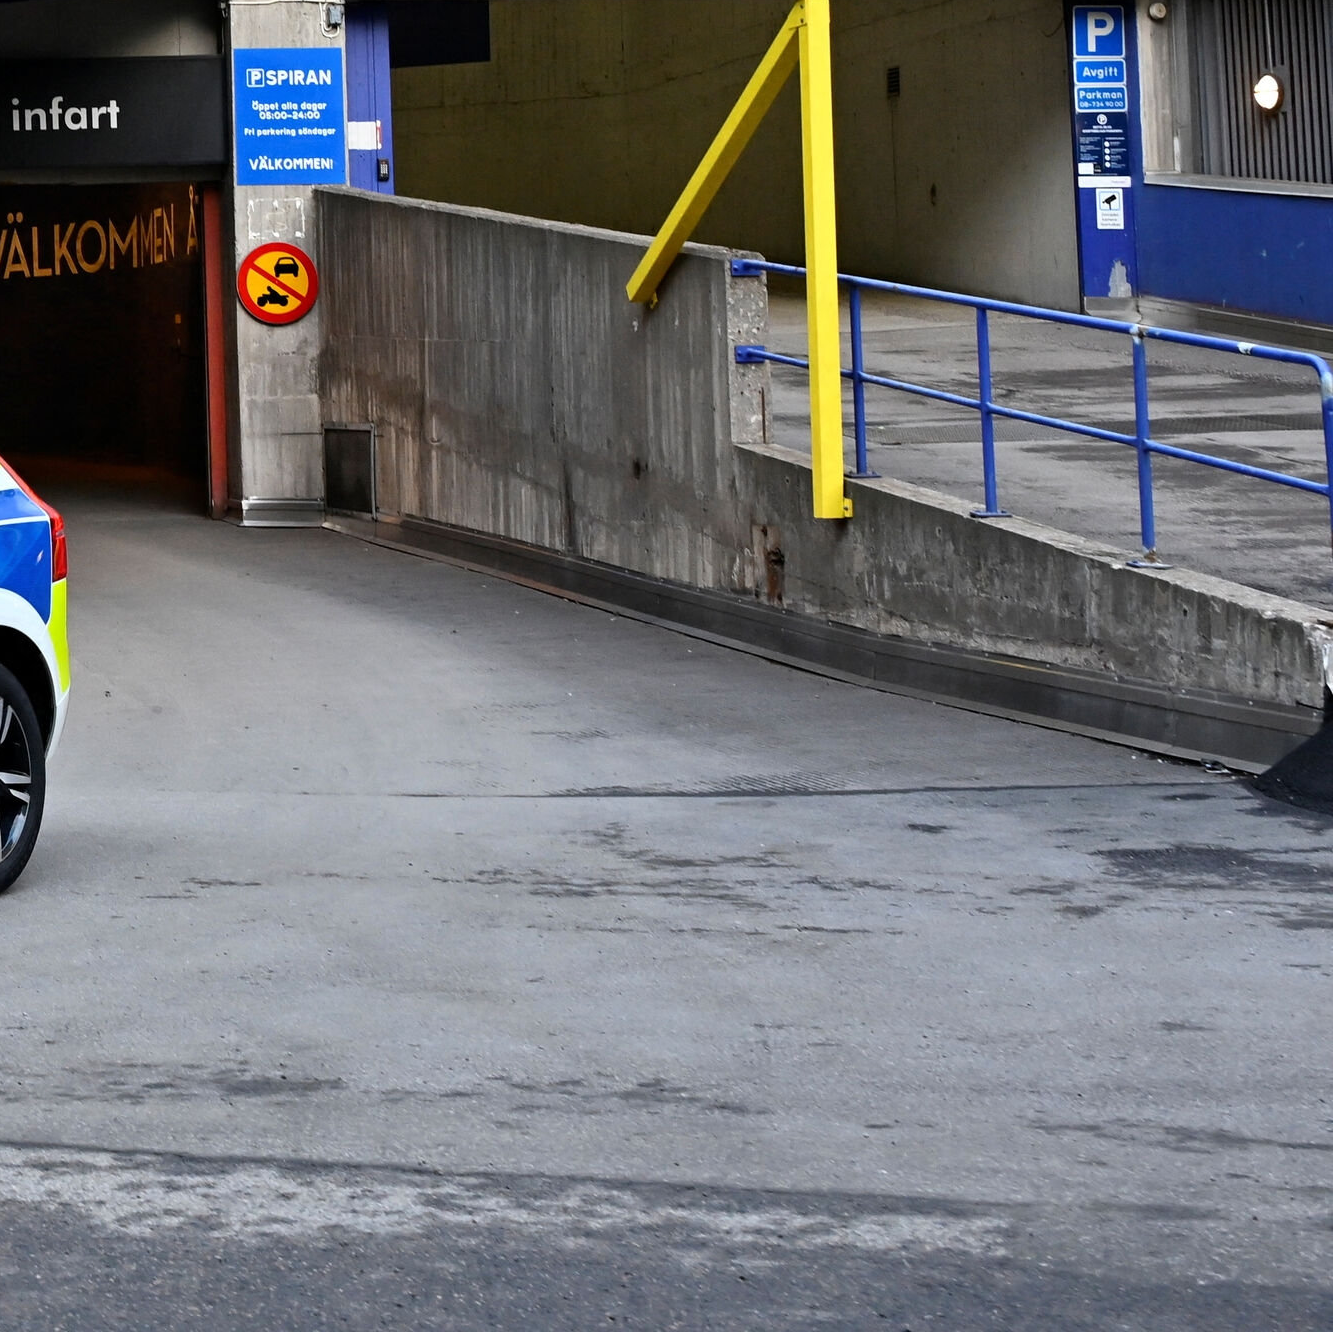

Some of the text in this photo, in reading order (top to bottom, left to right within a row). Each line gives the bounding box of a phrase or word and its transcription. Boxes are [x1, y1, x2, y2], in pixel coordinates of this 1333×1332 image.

[1087, 11, 1115, 52] P
[266, 69, 332, 86] SPIRAN
[1082, 66, 1118, 79] Avgift
[1079, 90, 1123, 99] Parkman
[252, 100, 327, 111] Öppet alla dagar
[11, 96, 121, 132] infart
[244, 127, 336, 137] Fri parkering söndagar
[249, 156, 334, 171] VÄLKOMMEN!
